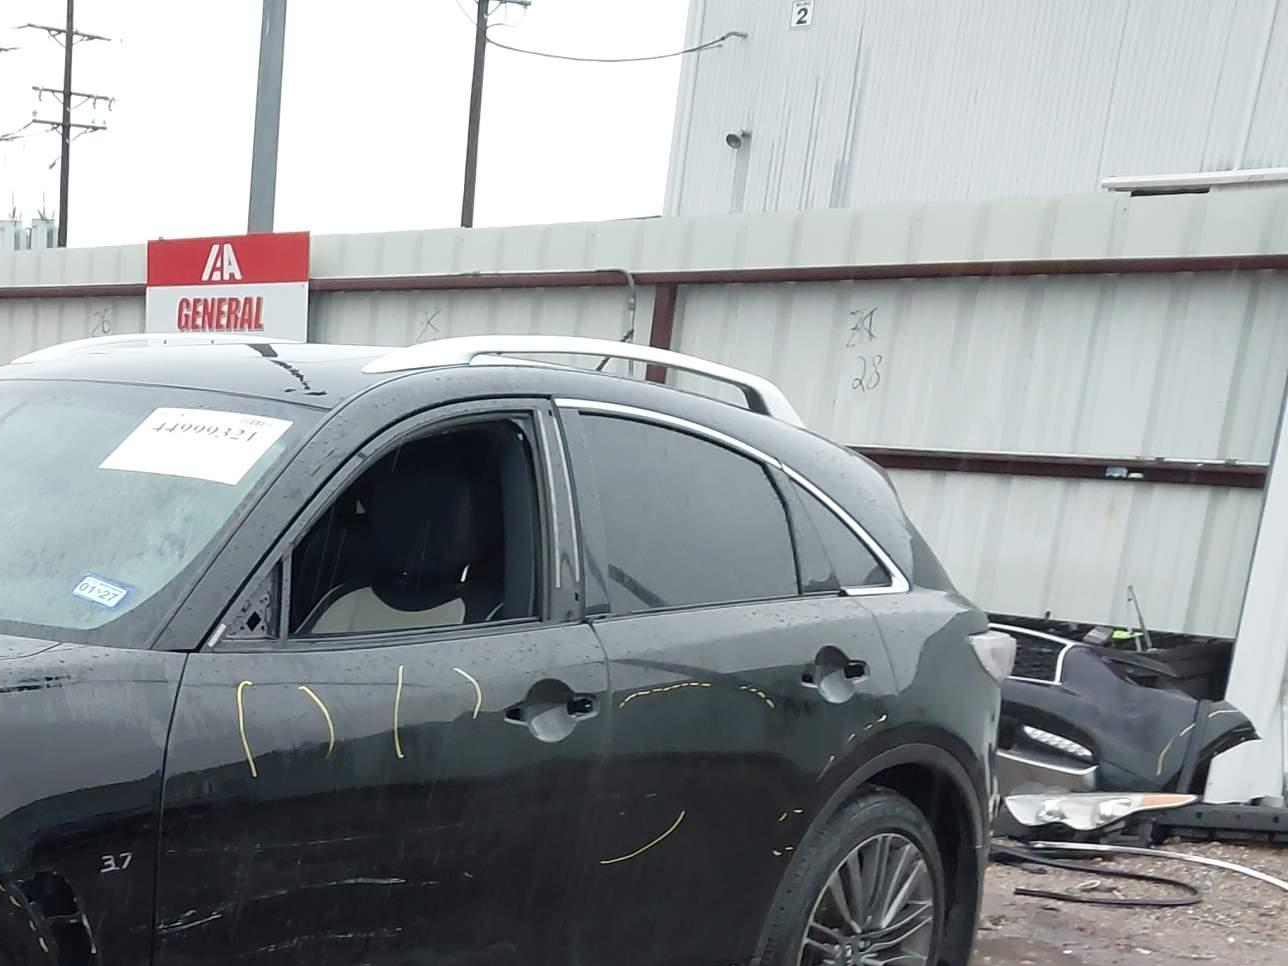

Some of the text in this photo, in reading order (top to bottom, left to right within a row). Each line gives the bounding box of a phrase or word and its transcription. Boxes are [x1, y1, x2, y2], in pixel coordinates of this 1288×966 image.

[795, 7, 809, 25] 2
[177, 296, 264, 332] GENERAL
[852, 354, 883, 392] 28
[152, 421, 258, 442] 44999321
